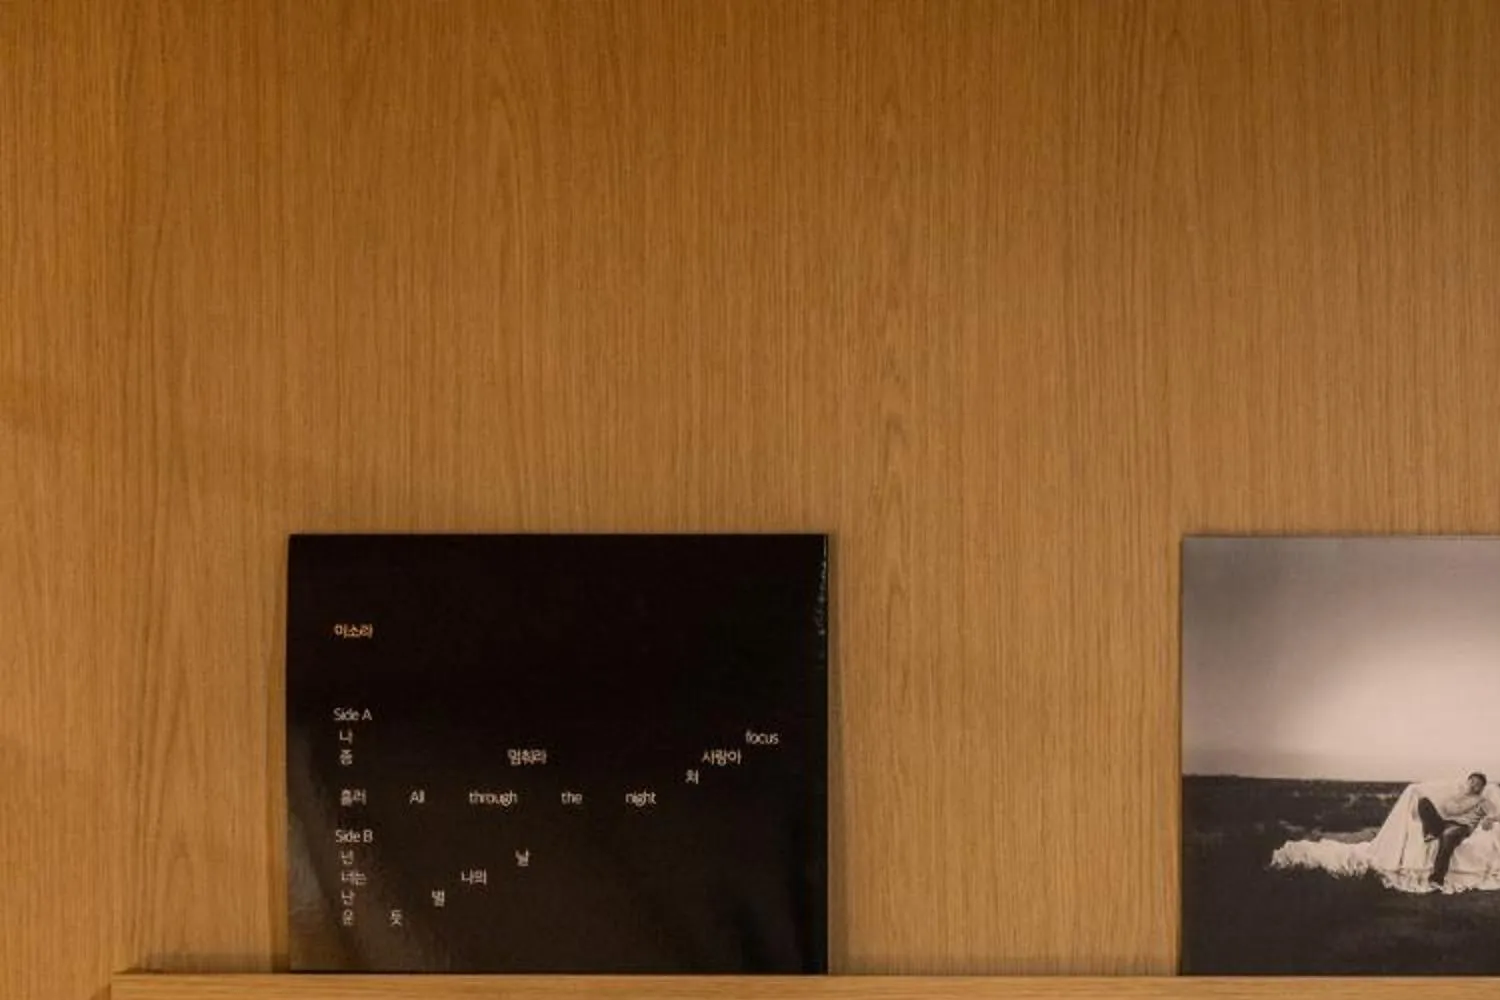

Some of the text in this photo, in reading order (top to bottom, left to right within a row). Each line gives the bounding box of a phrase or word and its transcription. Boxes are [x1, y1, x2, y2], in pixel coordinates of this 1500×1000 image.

[333, 623, 374, 639] 이소라
[333, 708, 373, 721] Side A
[339, 729, 780, 745] 나 focus
[507, 749, 547, 766] 멈춰라
[701, 749, 742, 766] 사랑아
[409, 790, 425, 804] All
[468, 789, 518, 807] through
[561, 791, 583, 805] the
[625, 790, 657, 808] night
[335, 829, 374, 843] Side B
[461, 869, 487, 885] 나의
